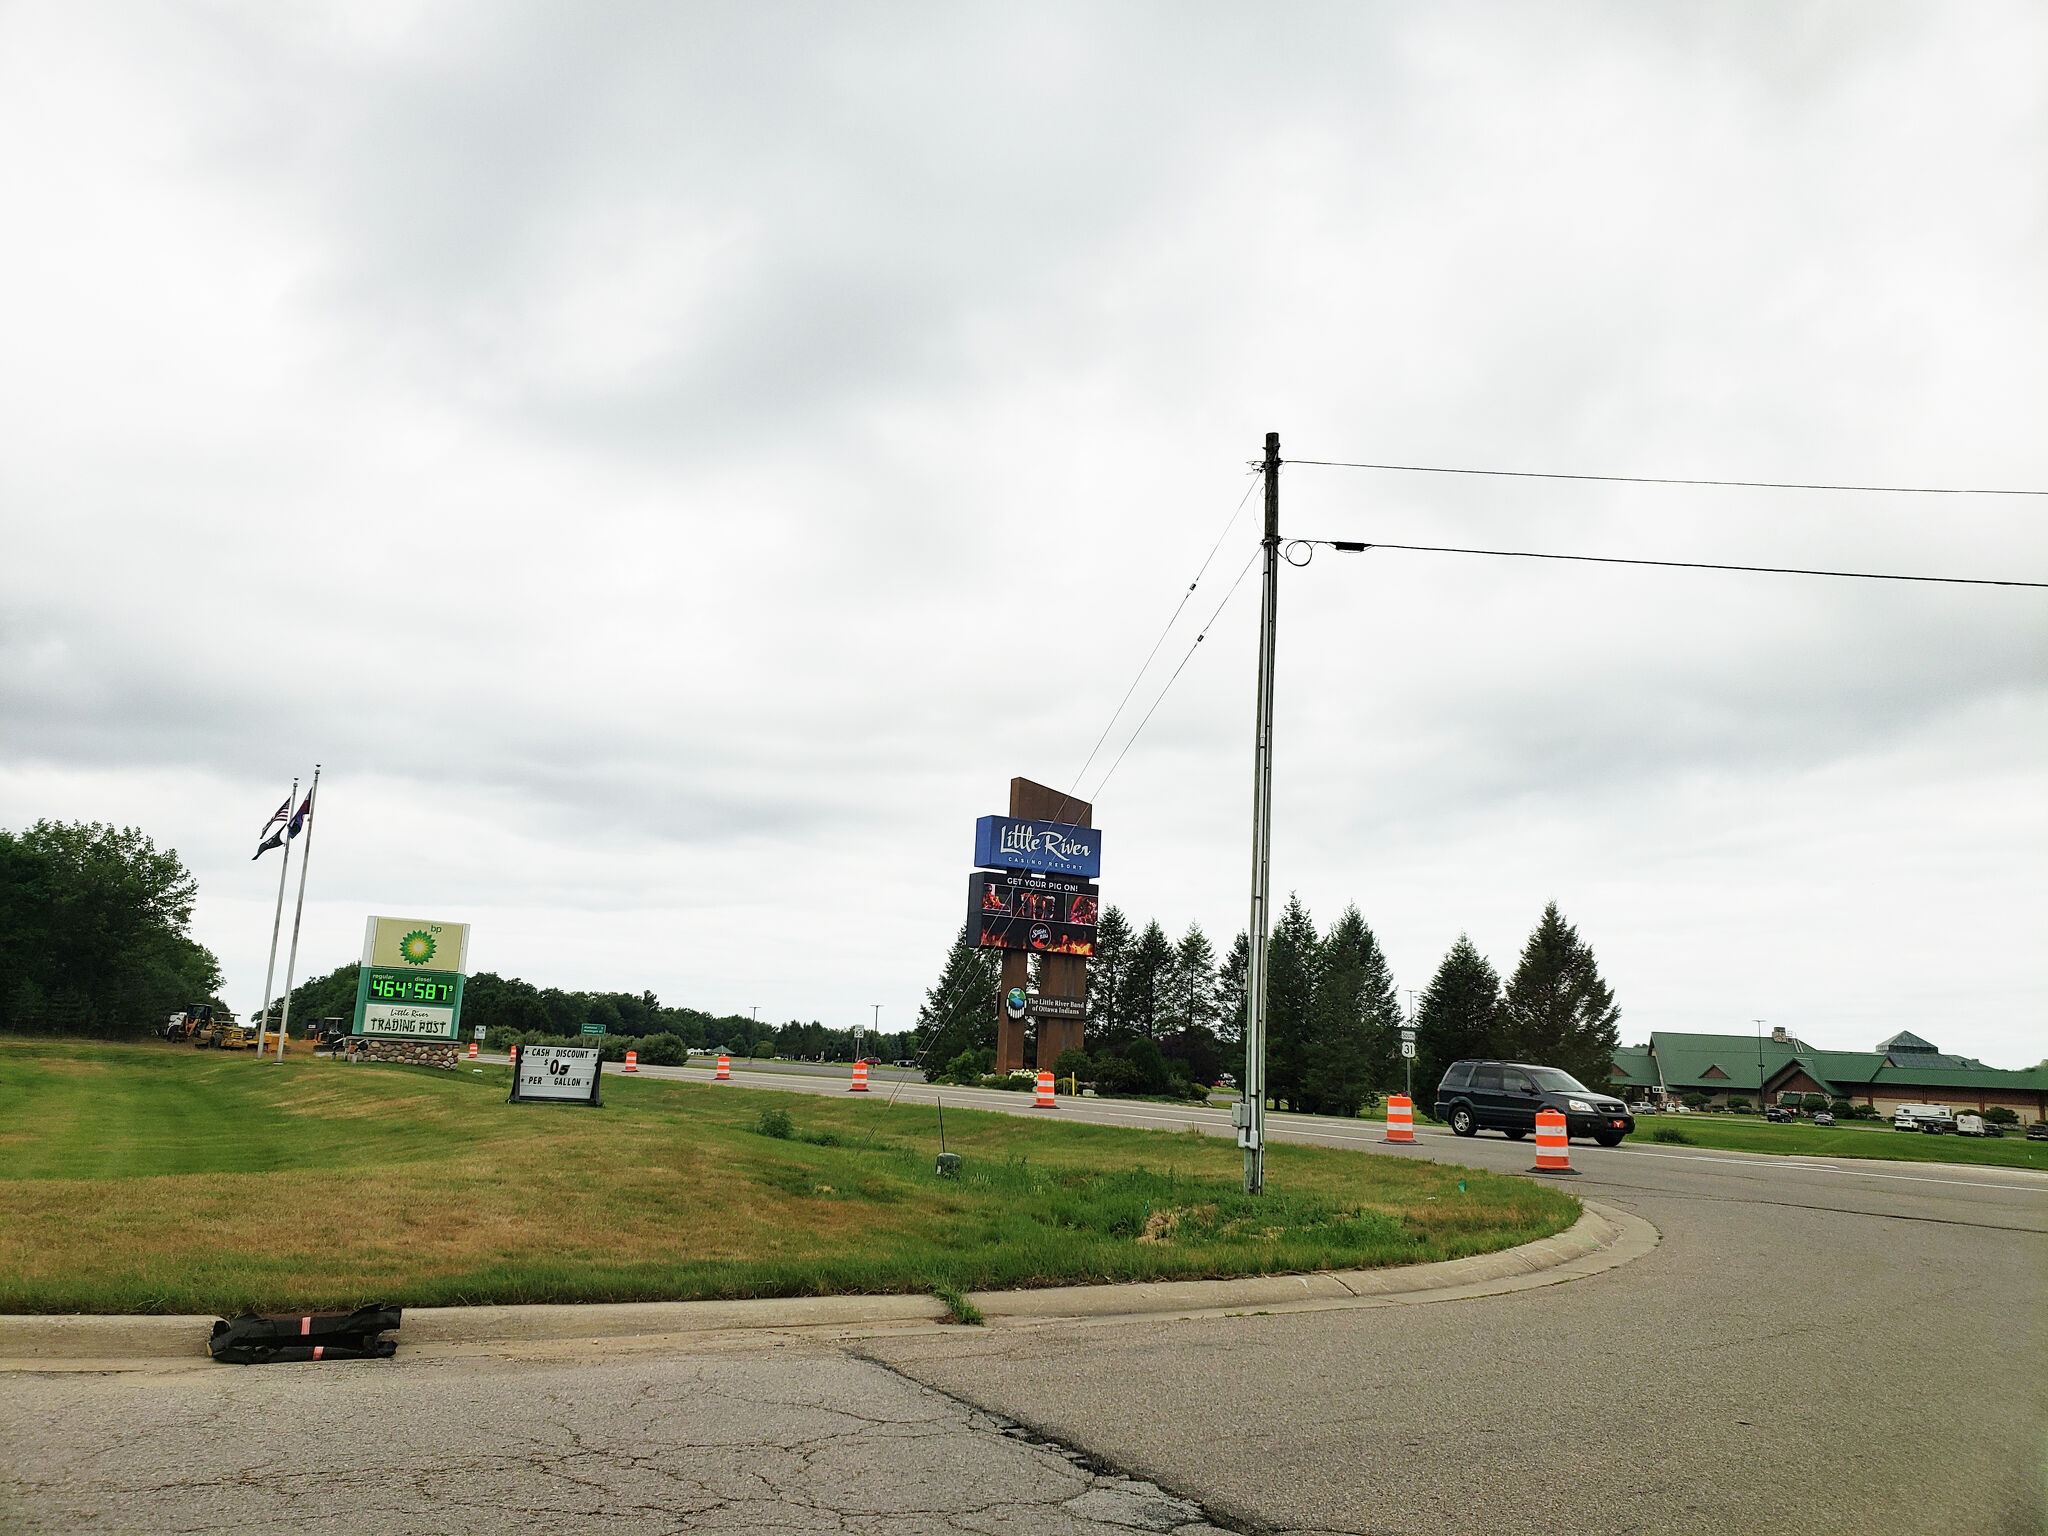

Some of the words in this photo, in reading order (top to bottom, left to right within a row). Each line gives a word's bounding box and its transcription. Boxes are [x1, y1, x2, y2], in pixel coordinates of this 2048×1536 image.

[1000, 824, 1041, 856] Little
[1037, 831, 1091, 861] River
[1008, 856, 1042, 865] CASINO
[1048, 861, 1083, 870] RESORT
[1007, 877, 1023, 886] GET
[1024, 879, 1047, 888] YOUR
[1048, 882, 1062, 890] PIG
[1063, 884, 1079, 892] ON!
[430, 924, 442, 934] bp
[1039, 998, 1055, 1006] Little
[390, 1008, 410, 1017] Little
[411, 1009, 429, 1018] River
[1038, 1005, 1058, 1013] Ottawa
[371, 1018, 416, 1033] TRADING
[419, 1019, 447, 1034] POST
[531, 1048, 550, 1057] CASH
[555, 1049, 589, 1059] DISCOUNT
[1403, 1044, 1413, 1055] 31
[528, 1076, 543, 1085] PER
[554, 1077, 582, 1086] GALLON
